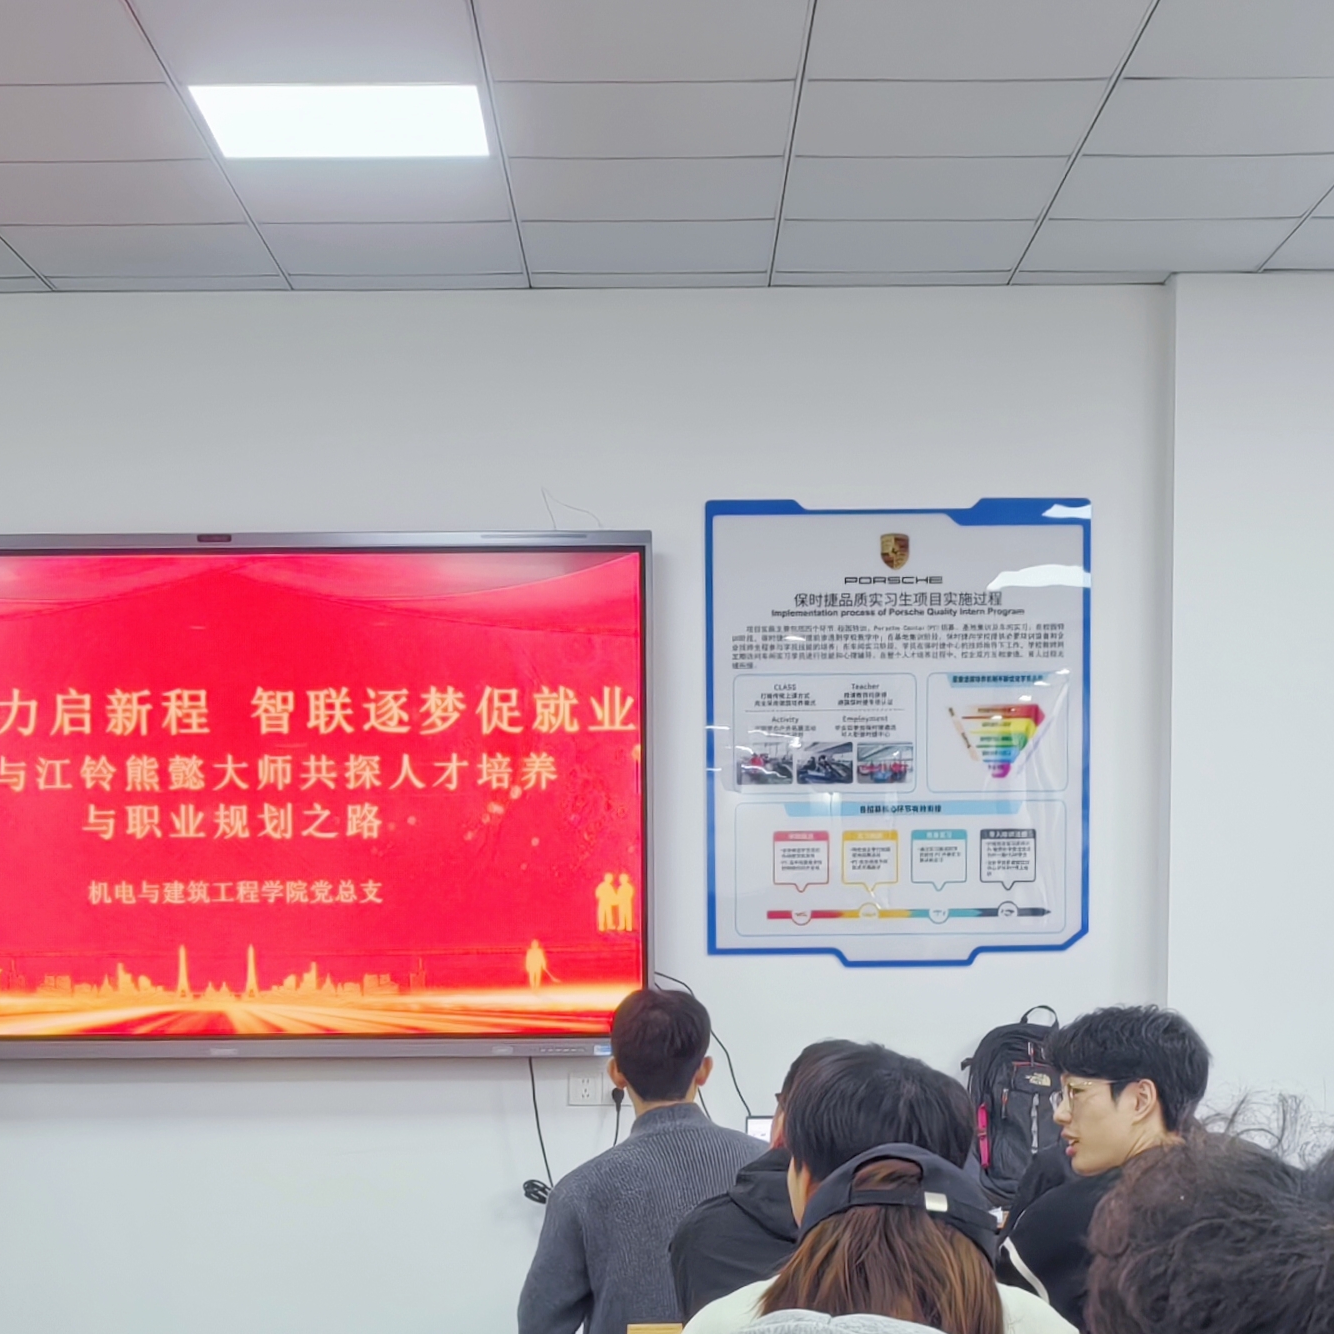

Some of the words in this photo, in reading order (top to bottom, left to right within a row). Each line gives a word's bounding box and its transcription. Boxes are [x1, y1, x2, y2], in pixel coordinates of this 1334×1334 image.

[844, 575, 943, 584] PORSCHE
[794, 592, 1003, 607] 保时捷品质实习生项目实施过程
[771, 609, 839, 618] Implementation
[840, 610, 875, 618] process
[877, 608, 887, 617] of
[888, 608, 925, 616] Porsche
[926, 608, 958, 617] Quality
[959, 608, 985, 616] Intern
[987, 608, 1025, 617] Program
[250, 686, 637, 737] 智联逐梦促就业
[771, 716, 799, 724] Activity
[842, 715, 889, 723] Employment
[82, 803, 384, 841] 与职业规划之路
[87, 879, 384, 906] 机电与建筑工程学院党总支
